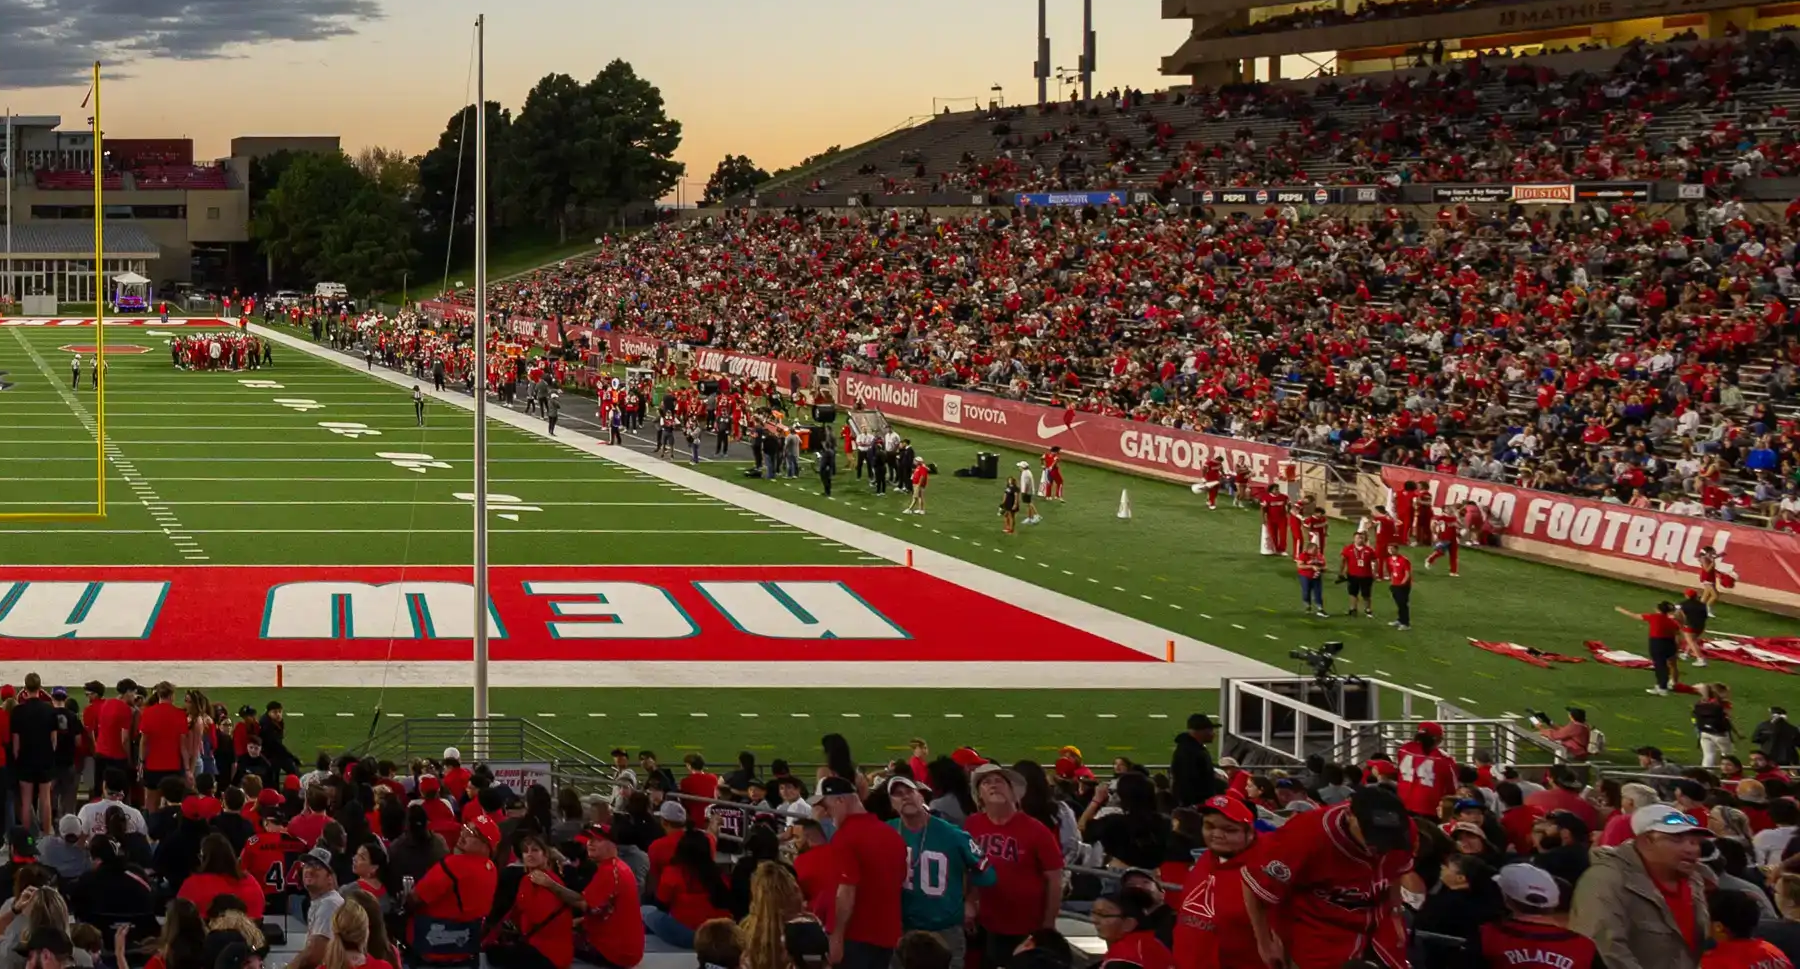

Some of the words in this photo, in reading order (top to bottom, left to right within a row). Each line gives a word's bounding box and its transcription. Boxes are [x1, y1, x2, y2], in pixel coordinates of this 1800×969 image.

[1521, 1, 1612, 24] MATHIS
[1223, 194, 1246, 202] PEPSI
[1278, 193, 1303, 201] PEPSI
[1516, 187, 1569, 199] HOUSTON
[724, 355, 777, 383] OOTBALL
[846, 376, 918, 408] ExxonMobil
[963, 404, 1006, 424] TOYOTA
[1523, 498, 1738, 581] FOOTBALL
[261, 581, 912, 639] NEW
[1399, 754, 1436, 788] 44
[978, 832, 1019, 862] USA
[1504, 948, 1573, 969] PALACIO
